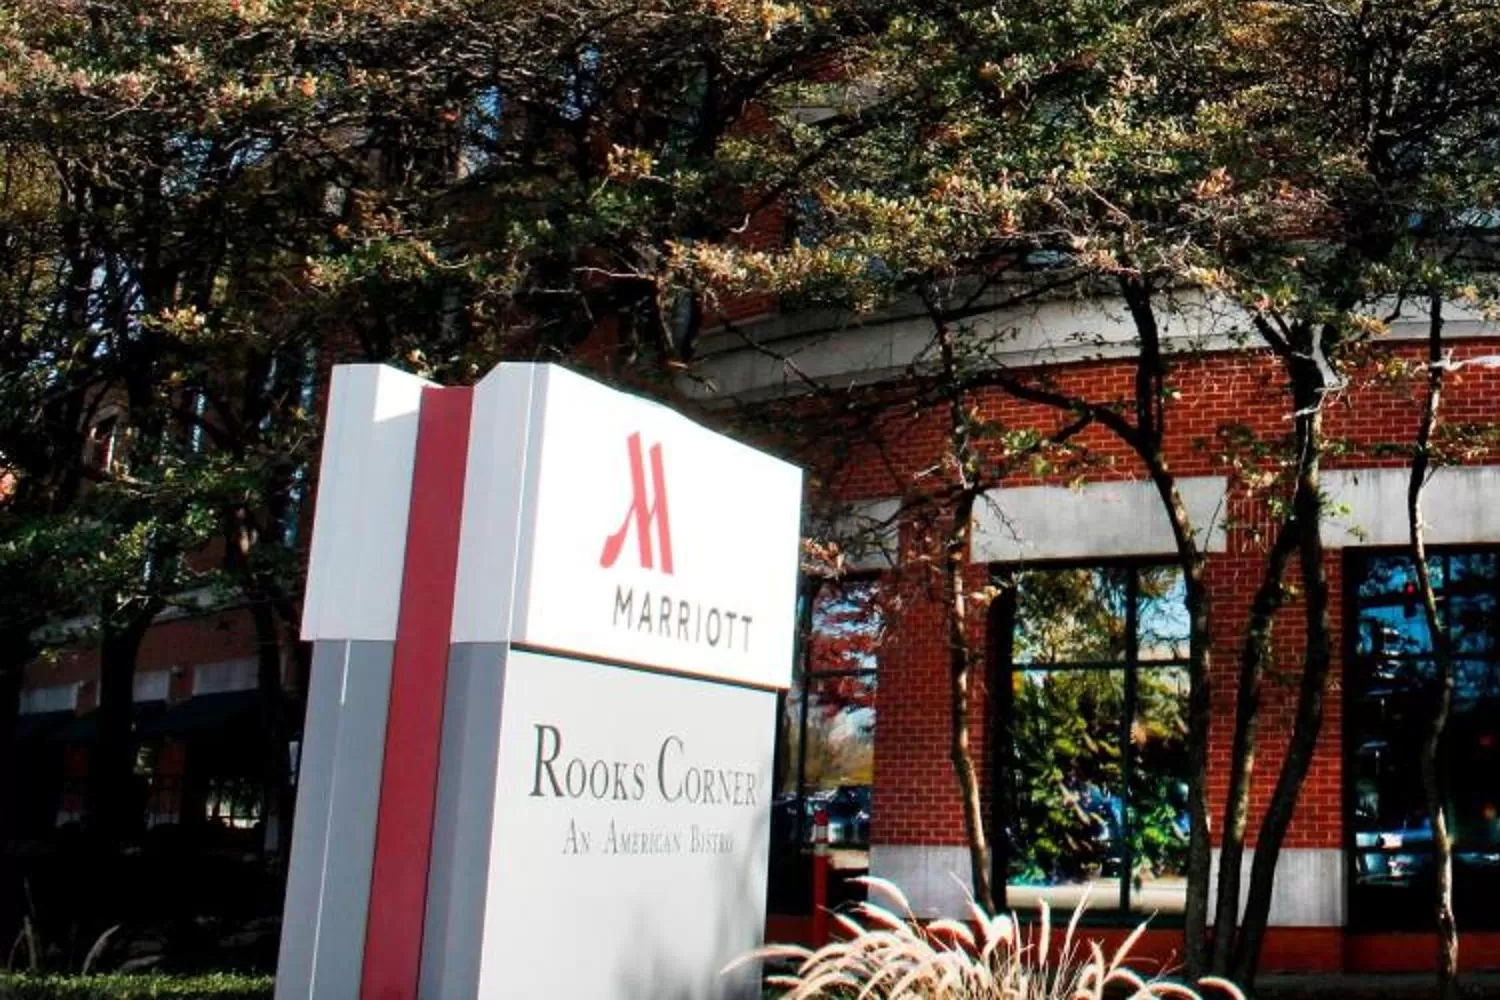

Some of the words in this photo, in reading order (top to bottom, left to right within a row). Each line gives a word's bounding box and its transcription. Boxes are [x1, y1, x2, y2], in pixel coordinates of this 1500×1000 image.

[612, 584, 752, 653] MARRIOTT
[528, 723, 645, 802] ROOKS
[657, 735, 757, 807] CORNER
[562, 817, 591, 855] AN
[603, 818, 681, 855] AMERICAN
